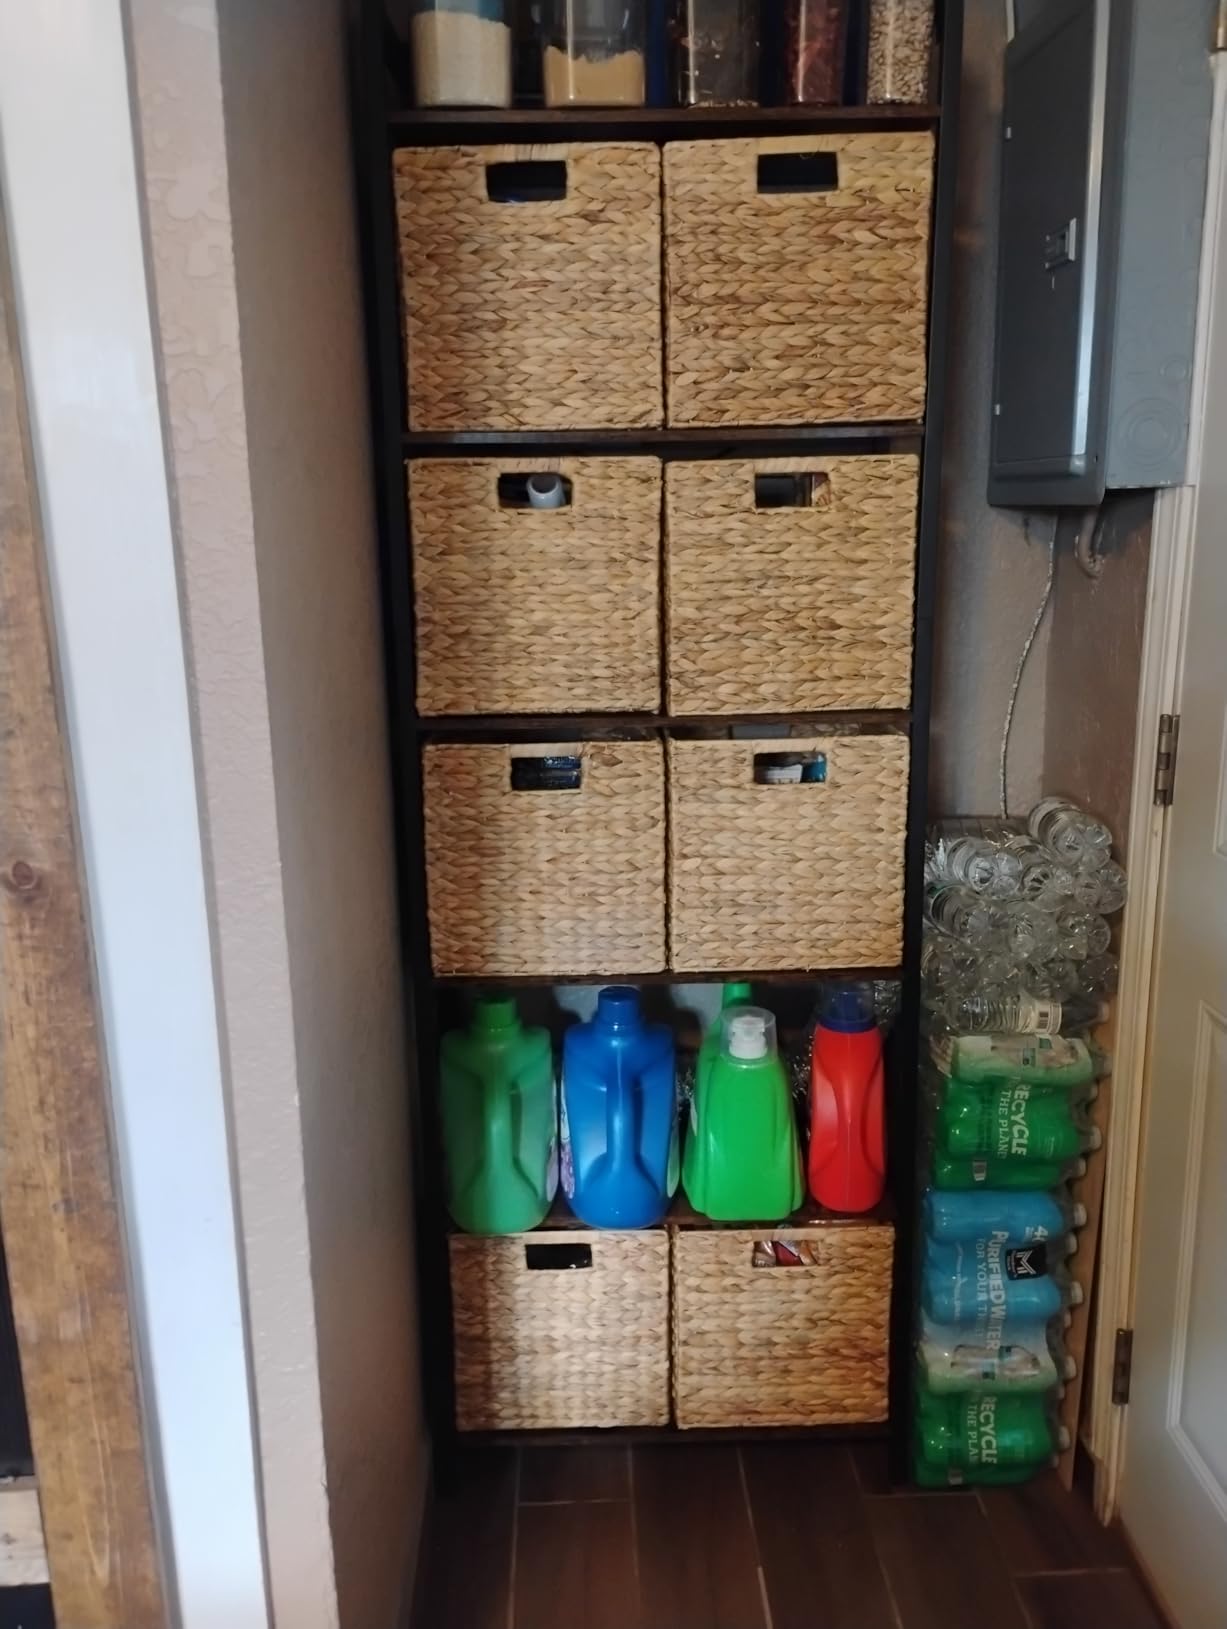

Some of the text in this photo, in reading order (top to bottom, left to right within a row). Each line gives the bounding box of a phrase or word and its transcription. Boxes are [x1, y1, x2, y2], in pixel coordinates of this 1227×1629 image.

[998, 1090, 1011, 1116] THE
[1010, 1084, 1031, 1156] RECYCLE
[976, 1238, 986, 1259] FOR
[987, 1230, 1010, 1304] PURIFIED
[976, 1261, 988, 1302] YOUR
[967, 1404, 979, 1427] THE
[979, 1396, 998, 1464] RECYCLE
